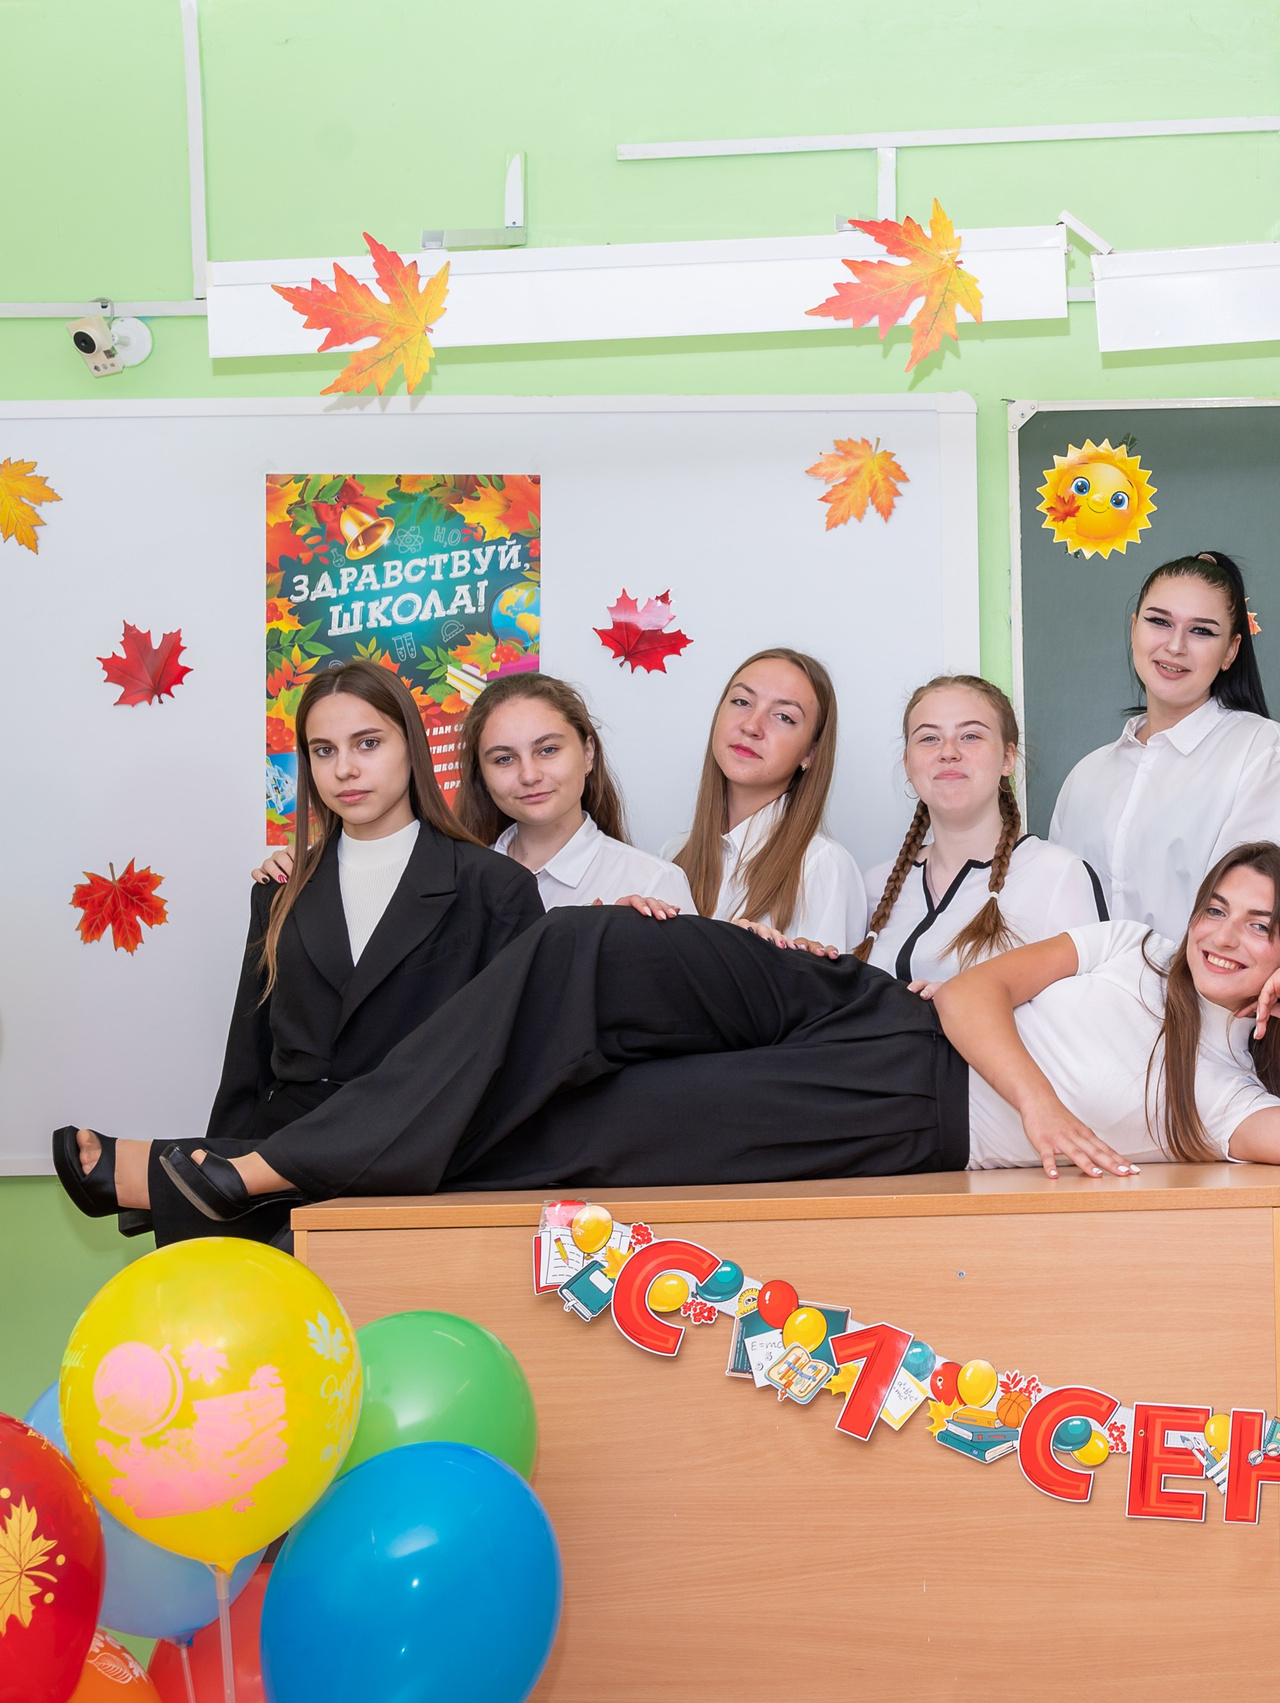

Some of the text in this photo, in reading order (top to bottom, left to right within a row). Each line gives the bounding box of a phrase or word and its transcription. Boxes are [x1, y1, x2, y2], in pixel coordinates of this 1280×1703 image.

[289, 539, 531, 603] ЗДРАВСТВУЙ,
[327, 579, 489, 637] ШКОЛА!
[611, 1238, 723, 1357] С
[828, 1321, 915, 1442] 1
